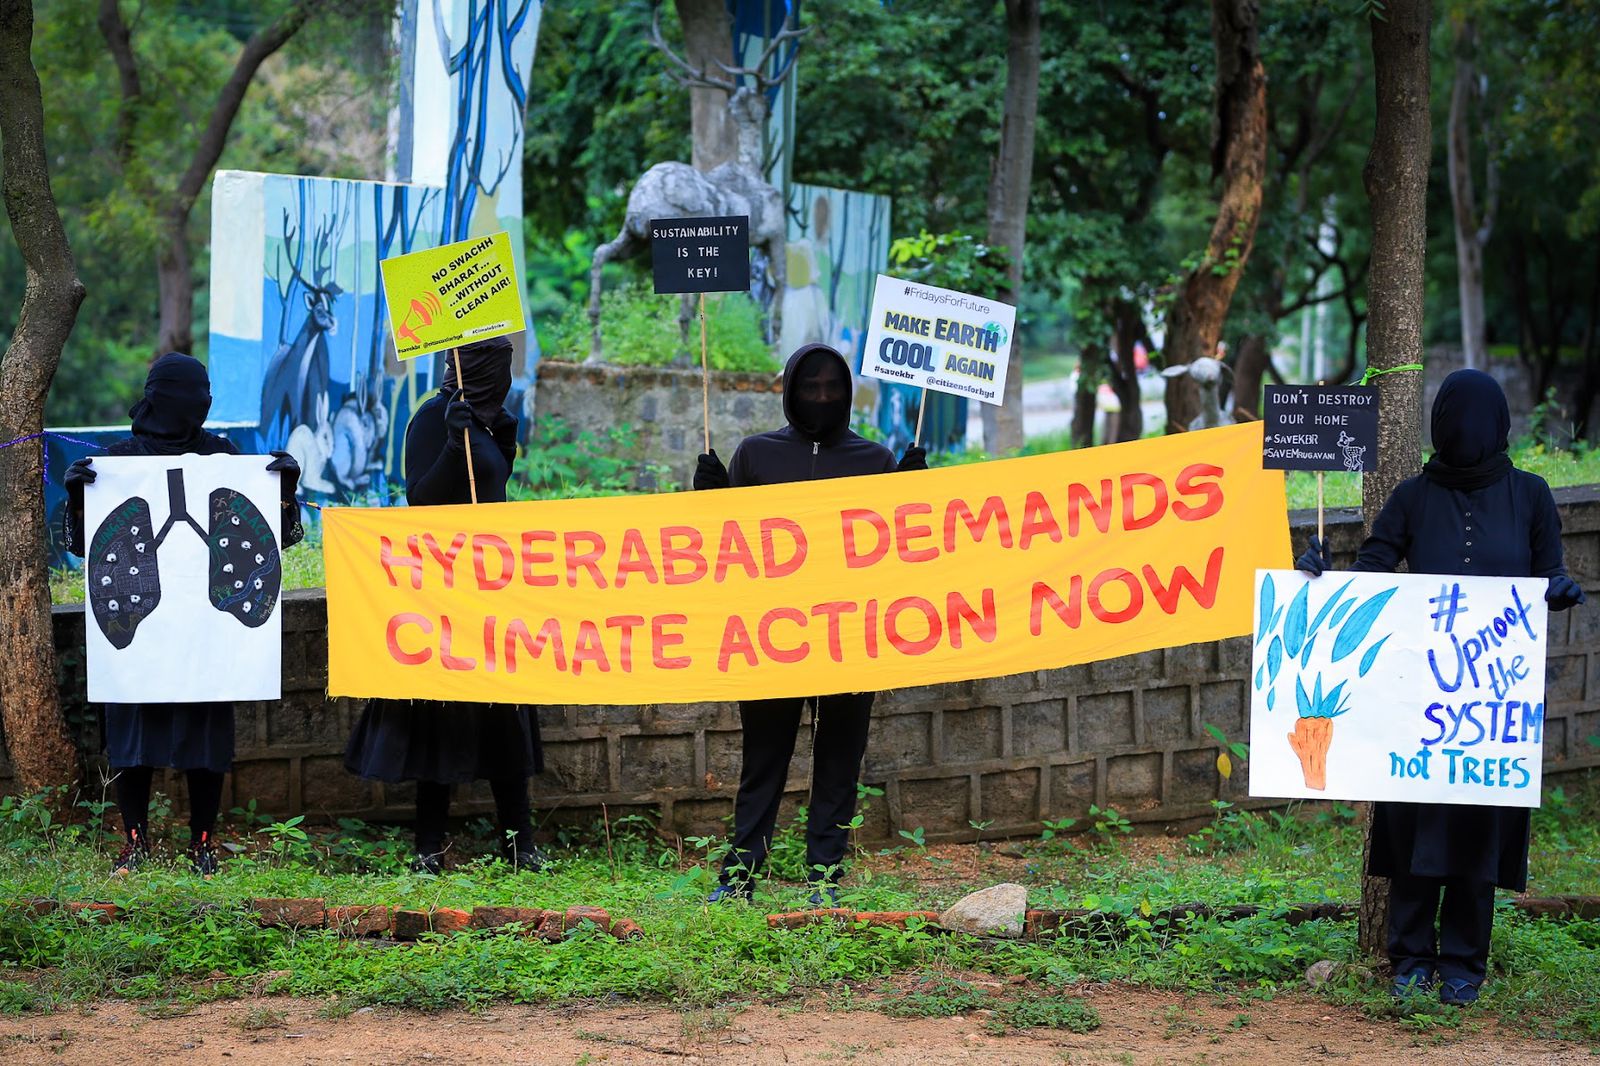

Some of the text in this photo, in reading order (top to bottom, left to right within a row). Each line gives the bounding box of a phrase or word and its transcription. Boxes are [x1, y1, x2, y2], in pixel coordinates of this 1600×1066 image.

[653, 226, 738, 238] SUSTAINABILITY
[678, 246, 720, 258] IS THE
[431, 237, 494, 282] NO SWACHH
[438, 262, 490, 296] BHARAT...
[688, 267, 718, 278] KEY!
[455, 276, 511, 319] CLEAN AIR!
[904, 286, 990, 314] #FridaysForFuture
[884, 311, 999, 353] MAKE EARTH
[879, 337, 995, 381] COOL AGAIN
[874, 365, 995, 398] #savekbr @citizensforhyd
[1273, 390, 1372, 406] DON'T DESTROY
[1280, 414, 1349, 426] OUR HOME
[230, 495, 272, 545] BLACK
[380, 463, 1224, 590] HYDERABAD DEMANDS
[386, 546, 1224, 676] CLIMATE ACTION NOW
[1488, 655, 1530, 700] the
[1420, 700, 1543, 746] SYSTEM
[1389, 746, 1530, 788] not TREES
